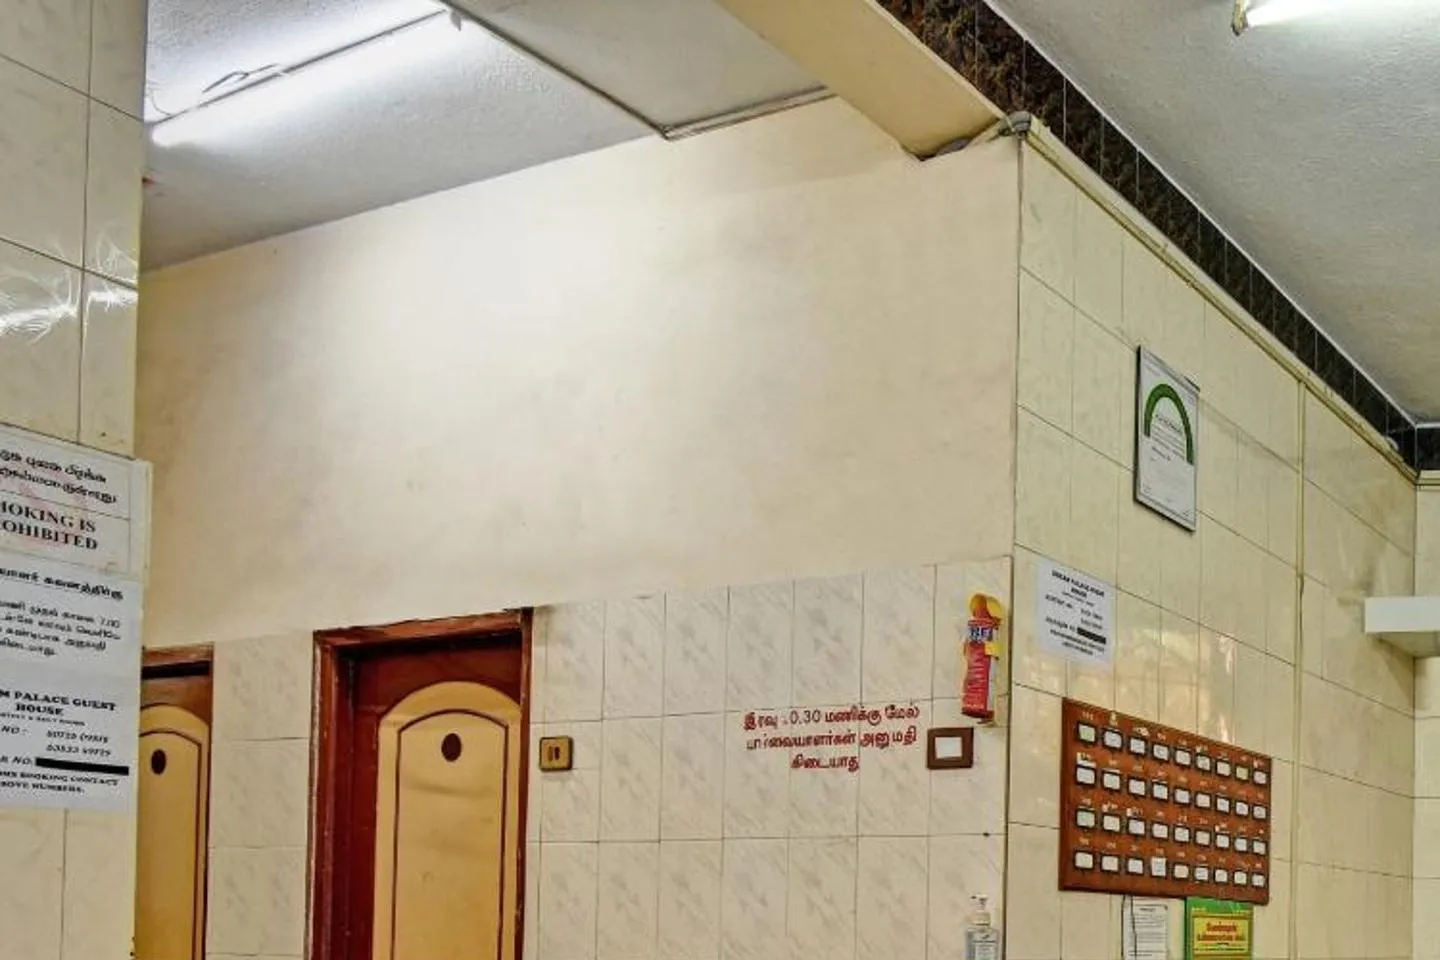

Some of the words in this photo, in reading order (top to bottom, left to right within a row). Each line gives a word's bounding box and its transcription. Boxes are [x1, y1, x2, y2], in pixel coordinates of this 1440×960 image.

[0, 501, 74, 529] OKING
[80, 519, 96, 533] IS
[0, 519, 98, 551] OHIBITED
[14, 691, 69, 706] PALACE
[16, 704, 63, 715] HOUSE
[783, 709, 821, 725] 0.30
[825, 704, 882, 726] மணிக்கு
